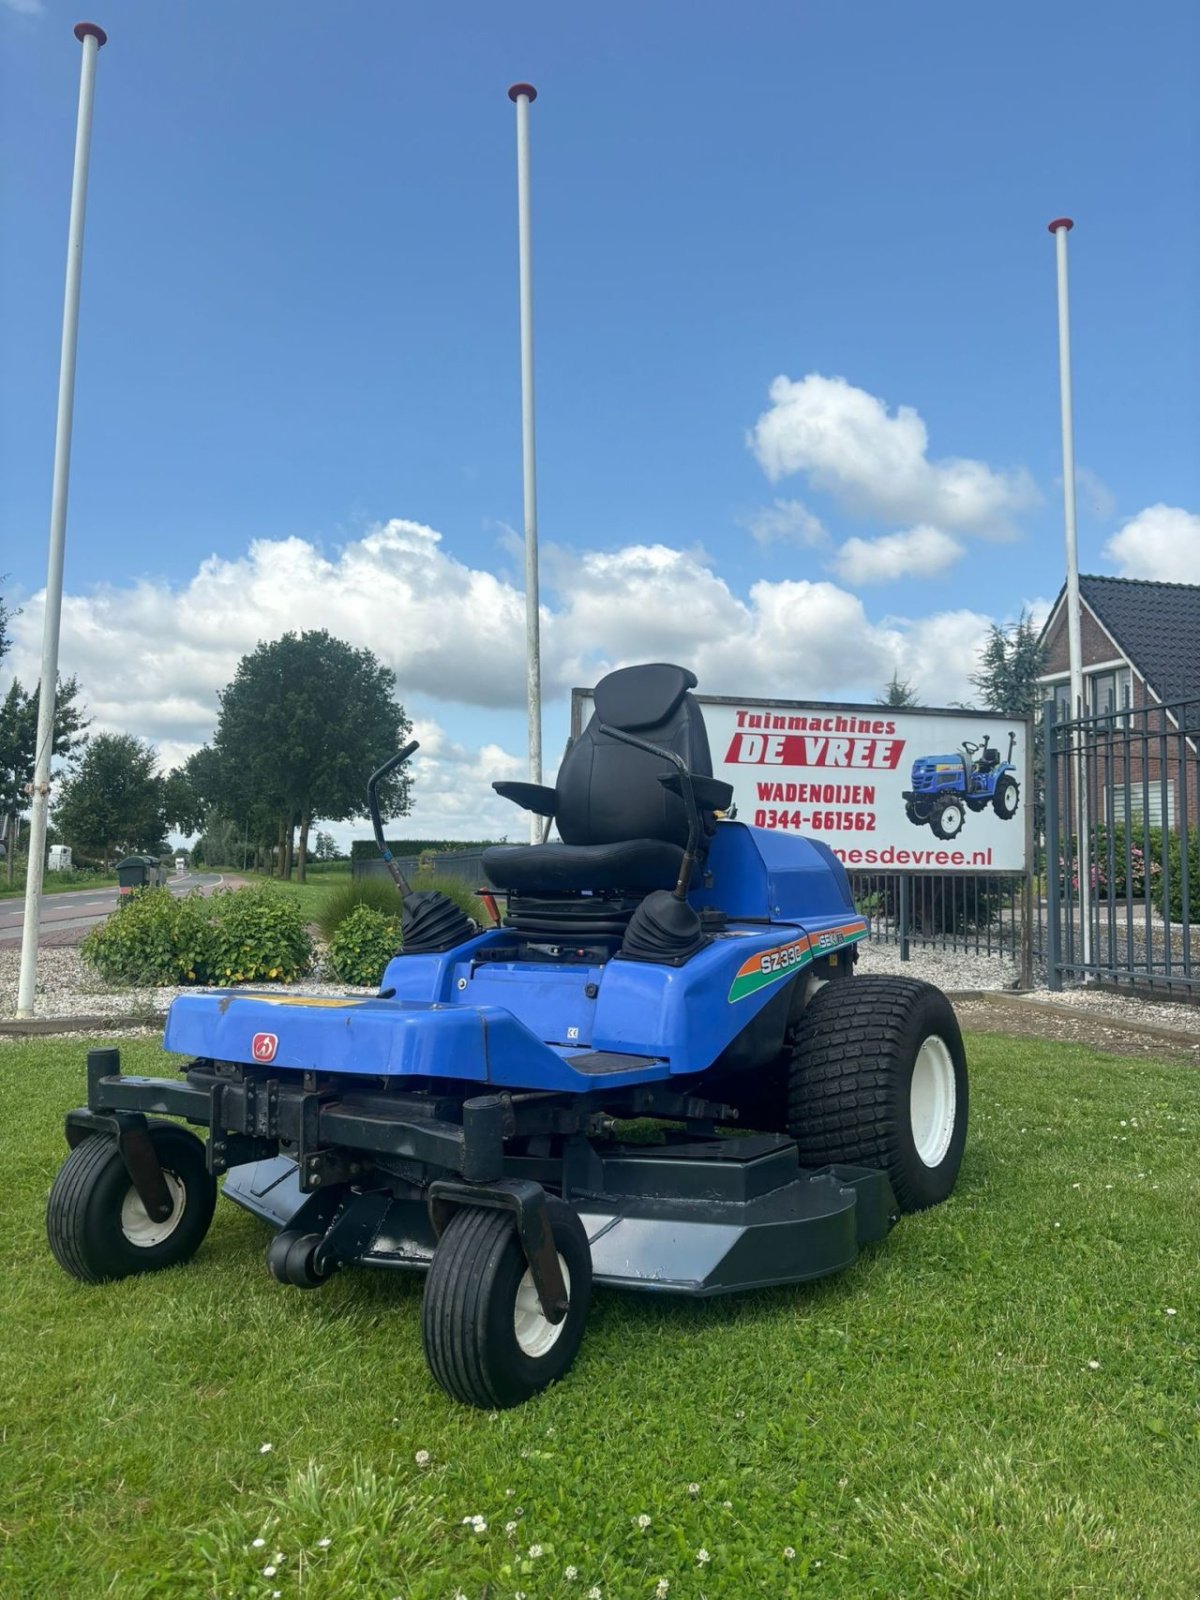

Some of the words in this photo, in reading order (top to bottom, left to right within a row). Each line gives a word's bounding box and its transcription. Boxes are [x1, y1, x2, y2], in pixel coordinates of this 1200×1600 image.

[736, 710, 896, 735] Tuinmachines
[738, 734, 786, 764] DE
[803, 737, 896, 768] VREE
[757, 782, 876, 805] WADENOIJEN
[755, 809, 876, 831] 0344-661562
[832, 846, 992, 865] nesdevree.nl
